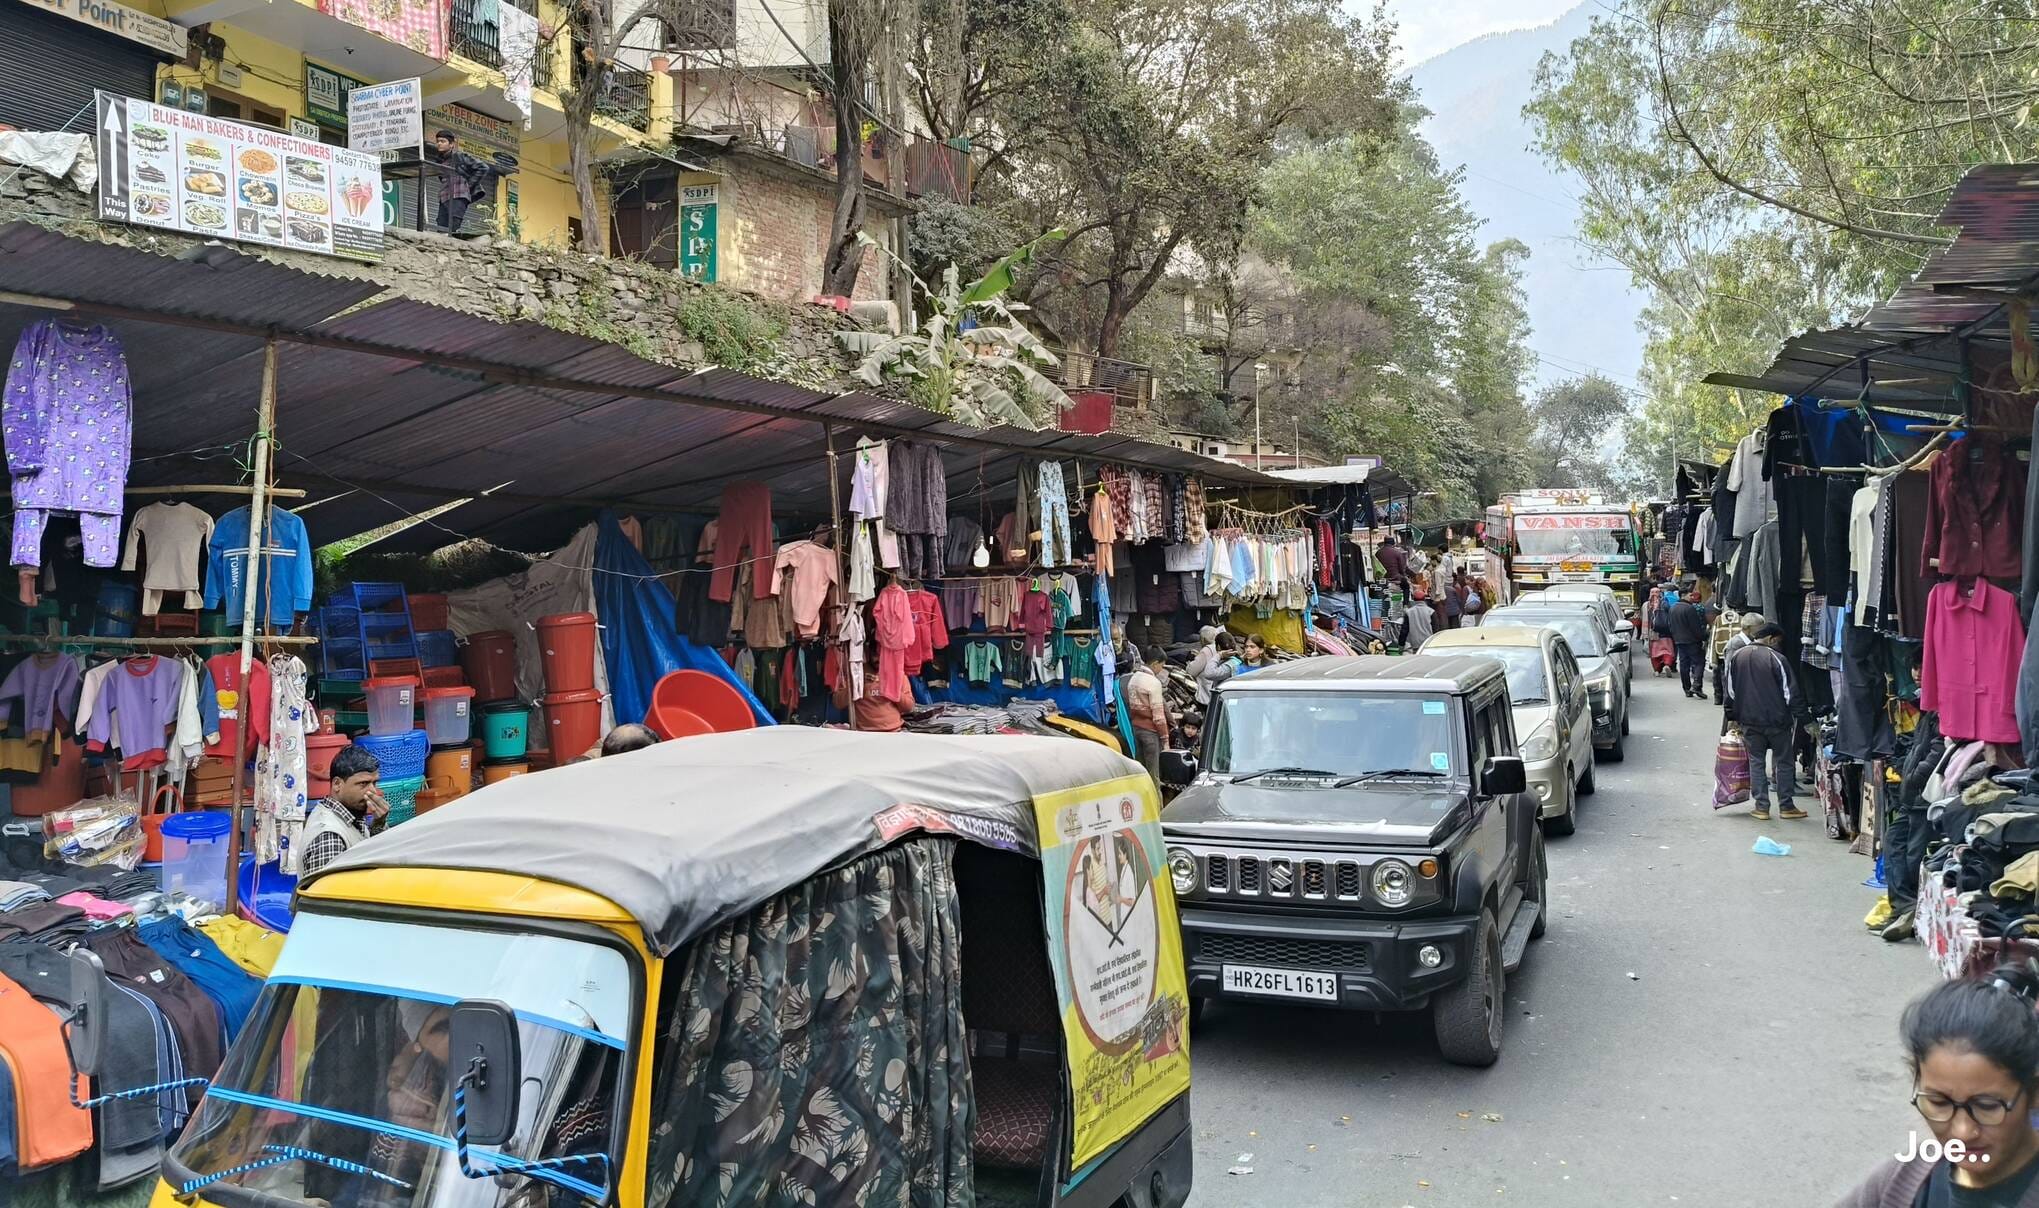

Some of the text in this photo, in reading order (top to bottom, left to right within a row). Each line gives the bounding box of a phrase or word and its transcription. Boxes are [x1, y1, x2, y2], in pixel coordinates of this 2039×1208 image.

[79, 0, 125, 30] Point
[375, 86, 393, 98] CYBER
[394, 83, 412, 96] POINT
[441, 103, 498, 130] CYBER ZONE
[426, 108, 463, 127] COMPUTER
[465, 121, 494, 136] TRAINING
[495, 130, 519, 145] CENTER
[152, 108, 331, 160] BLUE MAN BAKERS & CONFECTIONERS
[136, 151, 160, 160] Cake
[335, 154, 356, 168] 94597
[189, 160, 220, 171] Burger
[133, 182, 171, 194] Pastries
[104, 196, 127, 208] This
[246, 203, 277, 213] Momos
[104, 207, 127, 220] Way
[136, 216, 166, 226] Donut
[192, 225, 218, 235] Pasta
[1537, 488, 1589, 498] SONU
[1520, 516, 1626, 529] VANSH
[1233, 970, 1335, 995] HR26FL1613
